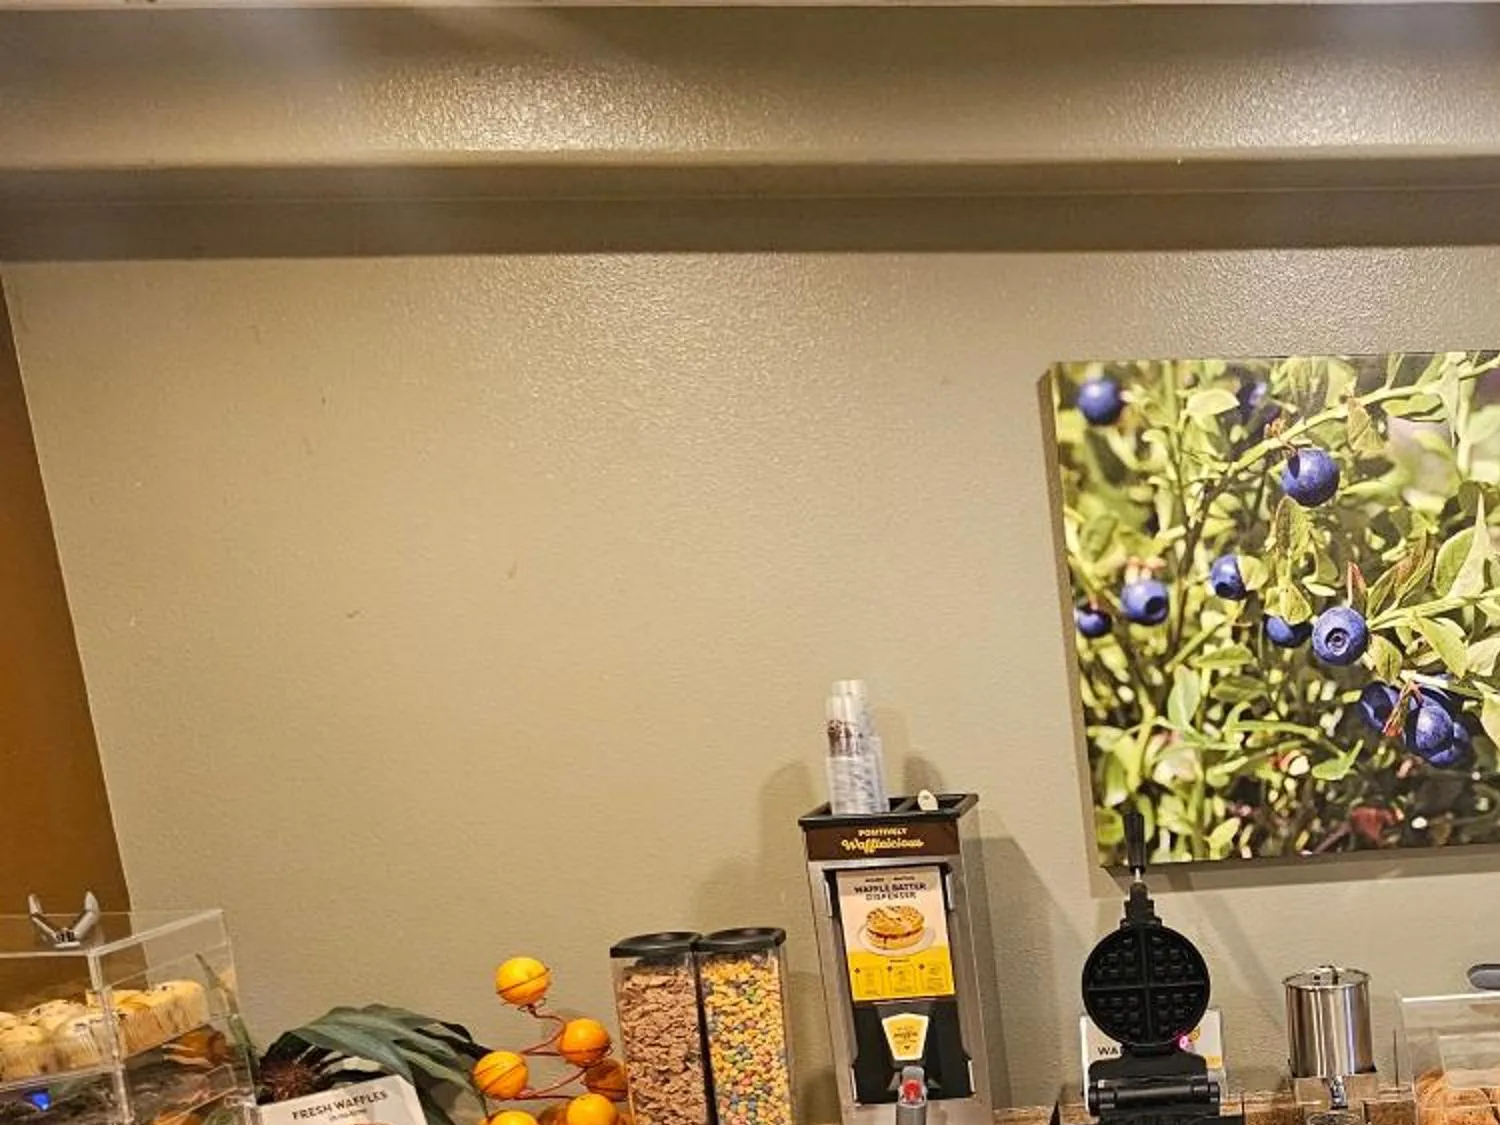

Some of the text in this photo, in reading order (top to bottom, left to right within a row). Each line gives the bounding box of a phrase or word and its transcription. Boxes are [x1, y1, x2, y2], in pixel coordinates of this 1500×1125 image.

[854, 881, 927, 894] WAFFLE BATTER
[291, 1103, 333, 1121] FRESH
[333, 1089, 388, 1111] WAFFLES
